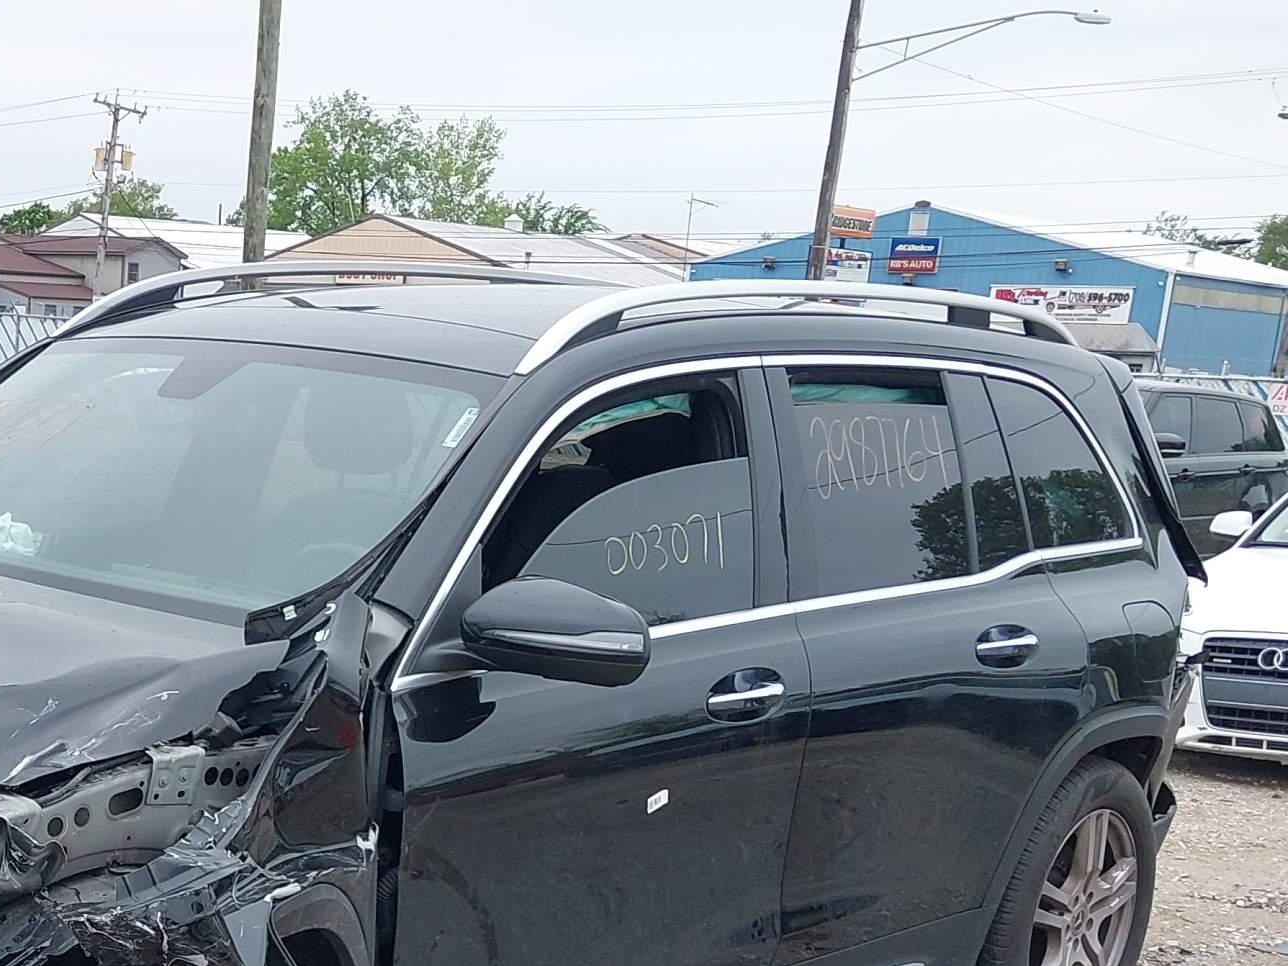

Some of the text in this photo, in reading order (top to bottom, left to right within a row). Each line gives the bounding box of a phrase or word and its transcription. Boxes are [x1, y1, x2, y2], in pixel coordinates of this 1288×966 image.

[909, 260, 934, 268] AUTO
[810, 415, 949, 499] 2987764
[604, 511, 724, 575] 003071
